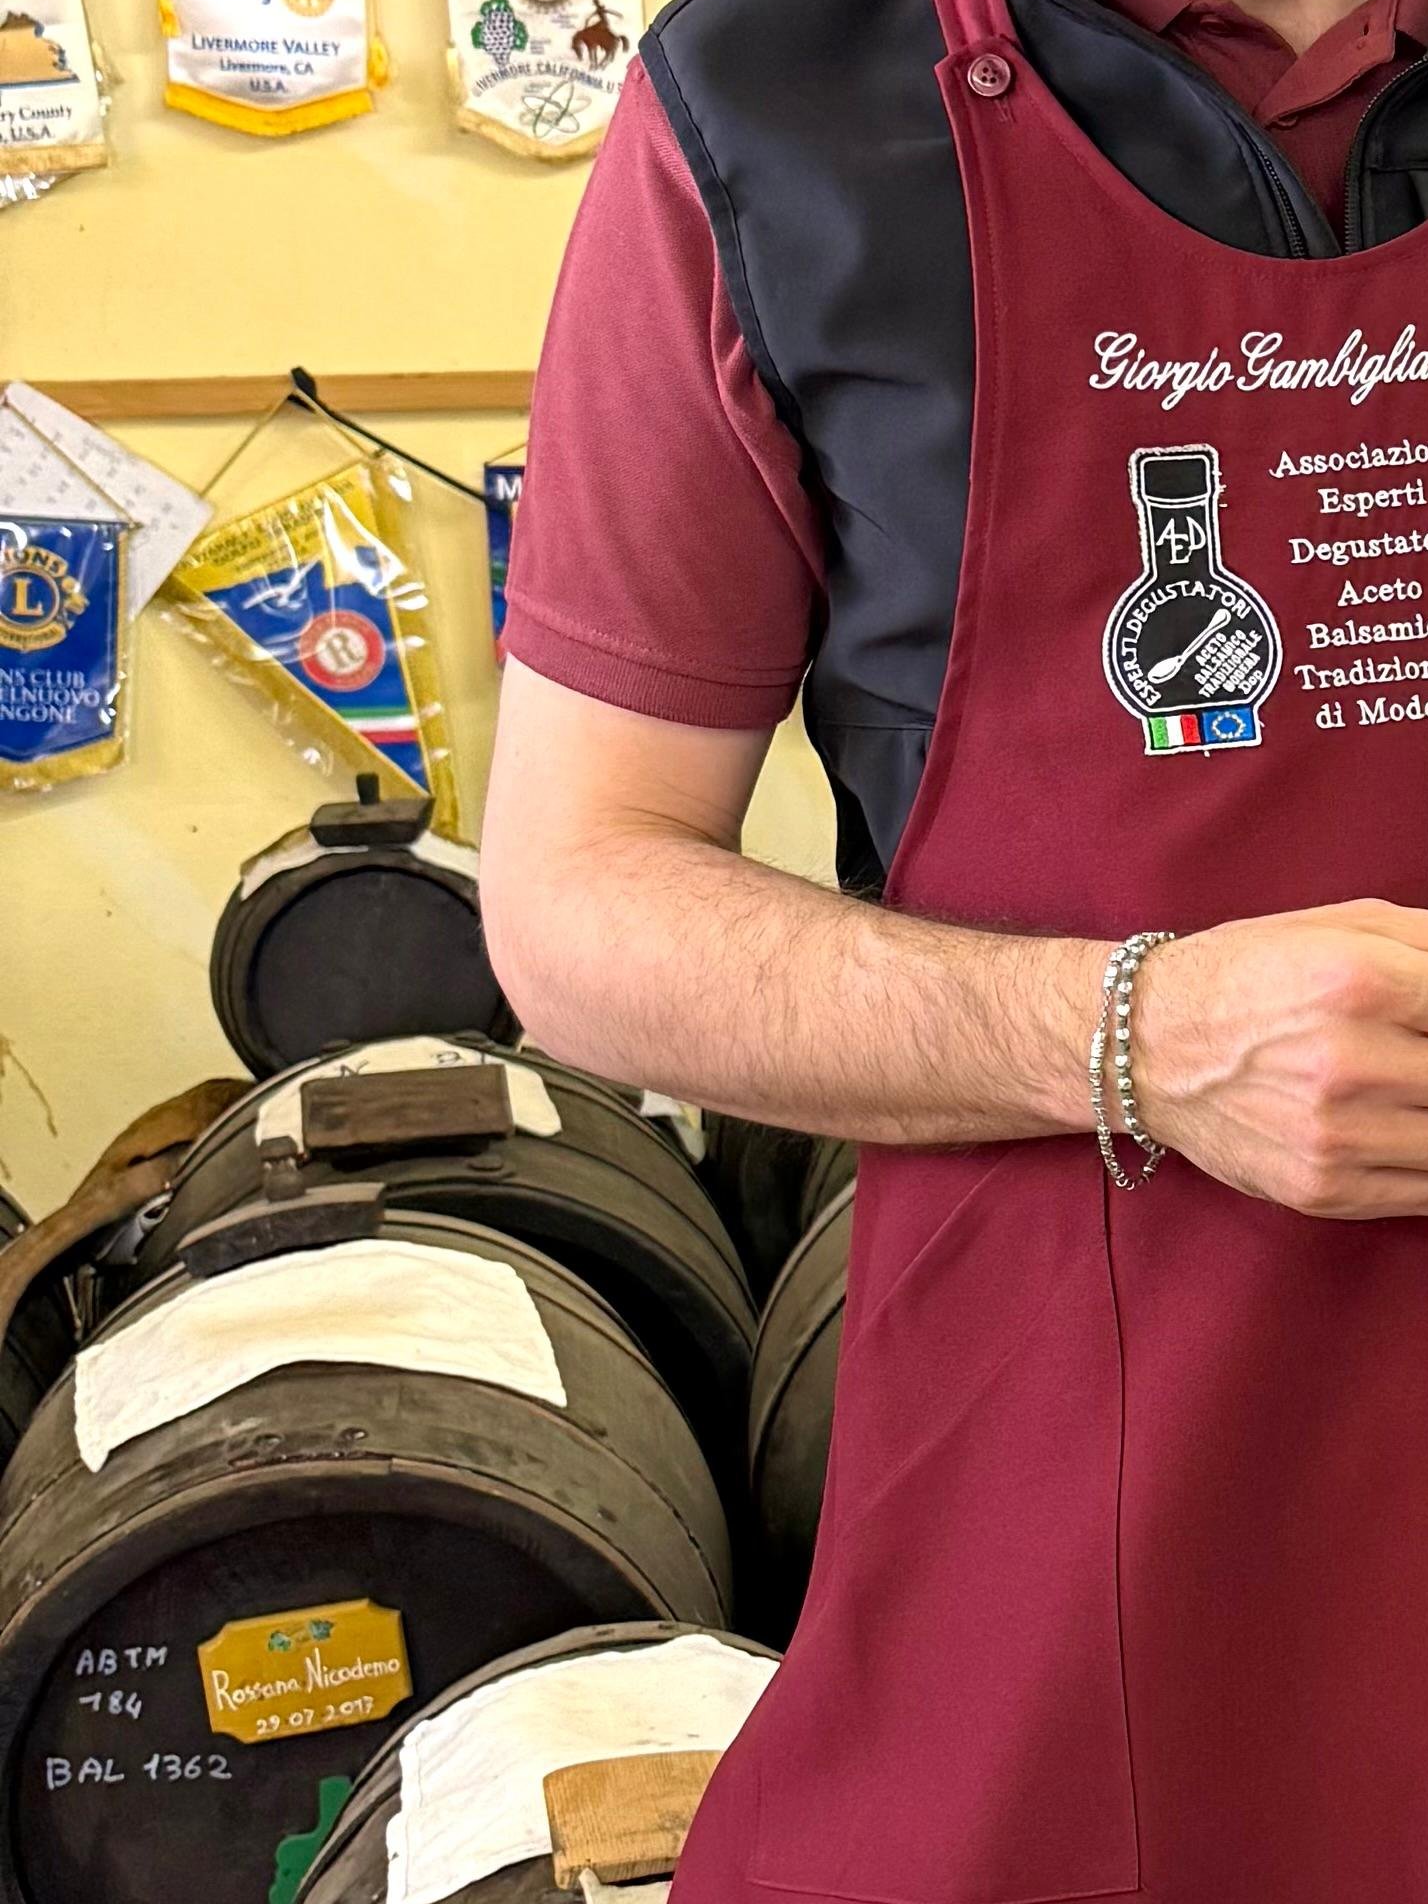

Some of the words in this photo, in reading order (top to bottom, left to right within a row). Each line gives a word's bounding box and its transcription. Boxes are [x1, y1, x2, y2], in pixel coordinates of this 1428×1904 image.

[191, 33, 278, 53] LIVERMORE
[282, 39, 341, 57] VALLEY
[1089, 331, 1234, 410] Giorgio
[1318, 478, 1427, 517] Esperti
[11, 577, 44, 616] L
[1126, 580, 1251, 637] DEGUSTATORI
[1337, 578, 1423, 607] Aceto
[30, 668, 86, 689] CLUB
[1121, 635, 1162, 706] ESPERTI
[1315, 701, 1346, 729] di
[75, 1646, 168, 1677] ABTM
[211, 1669, 300, 1712] Rossana
[306, 1647, 401, 1693] Nicodemo
[256, 1717, 280, 1735] 29
[288, 1710, 315, 1728] 07
[325, 1695, 375, 1722] 2017
[46, 1756, 125, 1790] BAL
[143, 1753, 233, 1782] 1362
